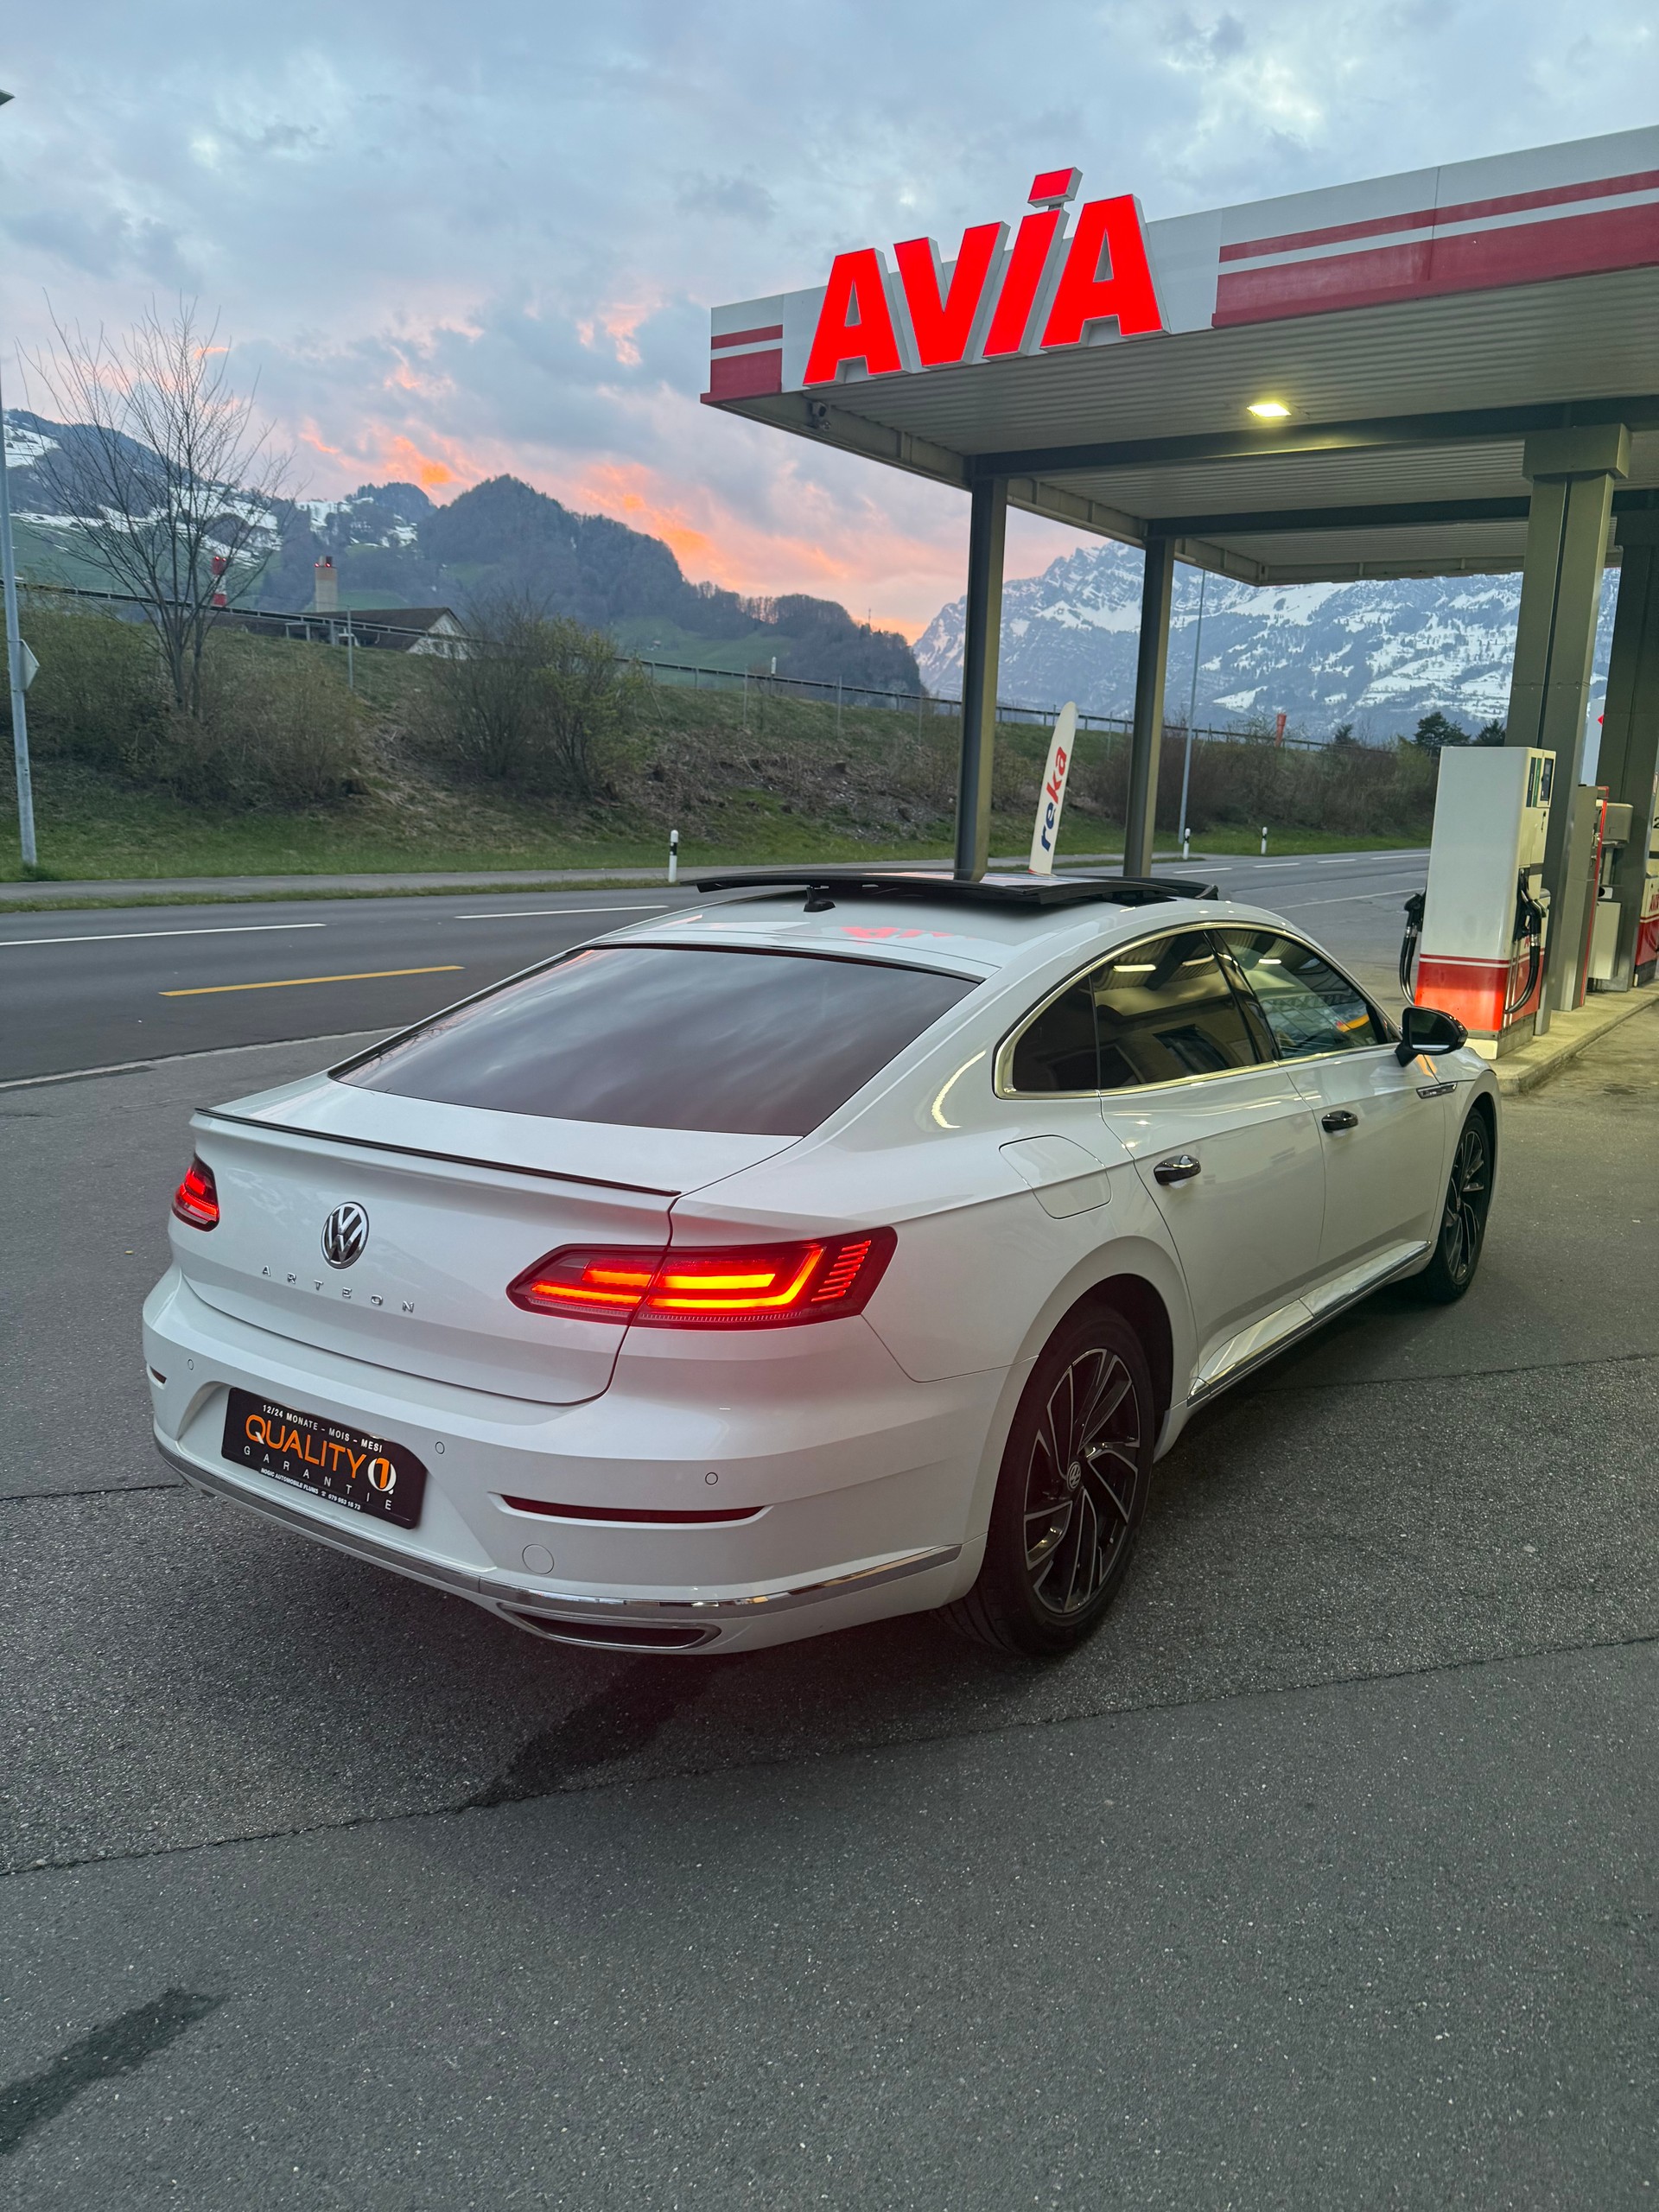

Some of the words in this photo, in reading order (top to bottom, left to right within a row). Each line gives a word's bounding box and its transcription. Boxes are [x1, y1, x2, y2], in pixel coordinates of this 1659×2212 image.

[1041, 747, 1067, 852] reka
[262, 1265, 415, 1313] ARTEON
[263, 1404, 283, 1418] 12/24
[286, 1410, 319, 1431] MONATE
[328, 1427, 350, 1442] MOIS
[361, 1439, 383, 1453] MESI
[244, 1446, 392, 1510] GARANTIE
